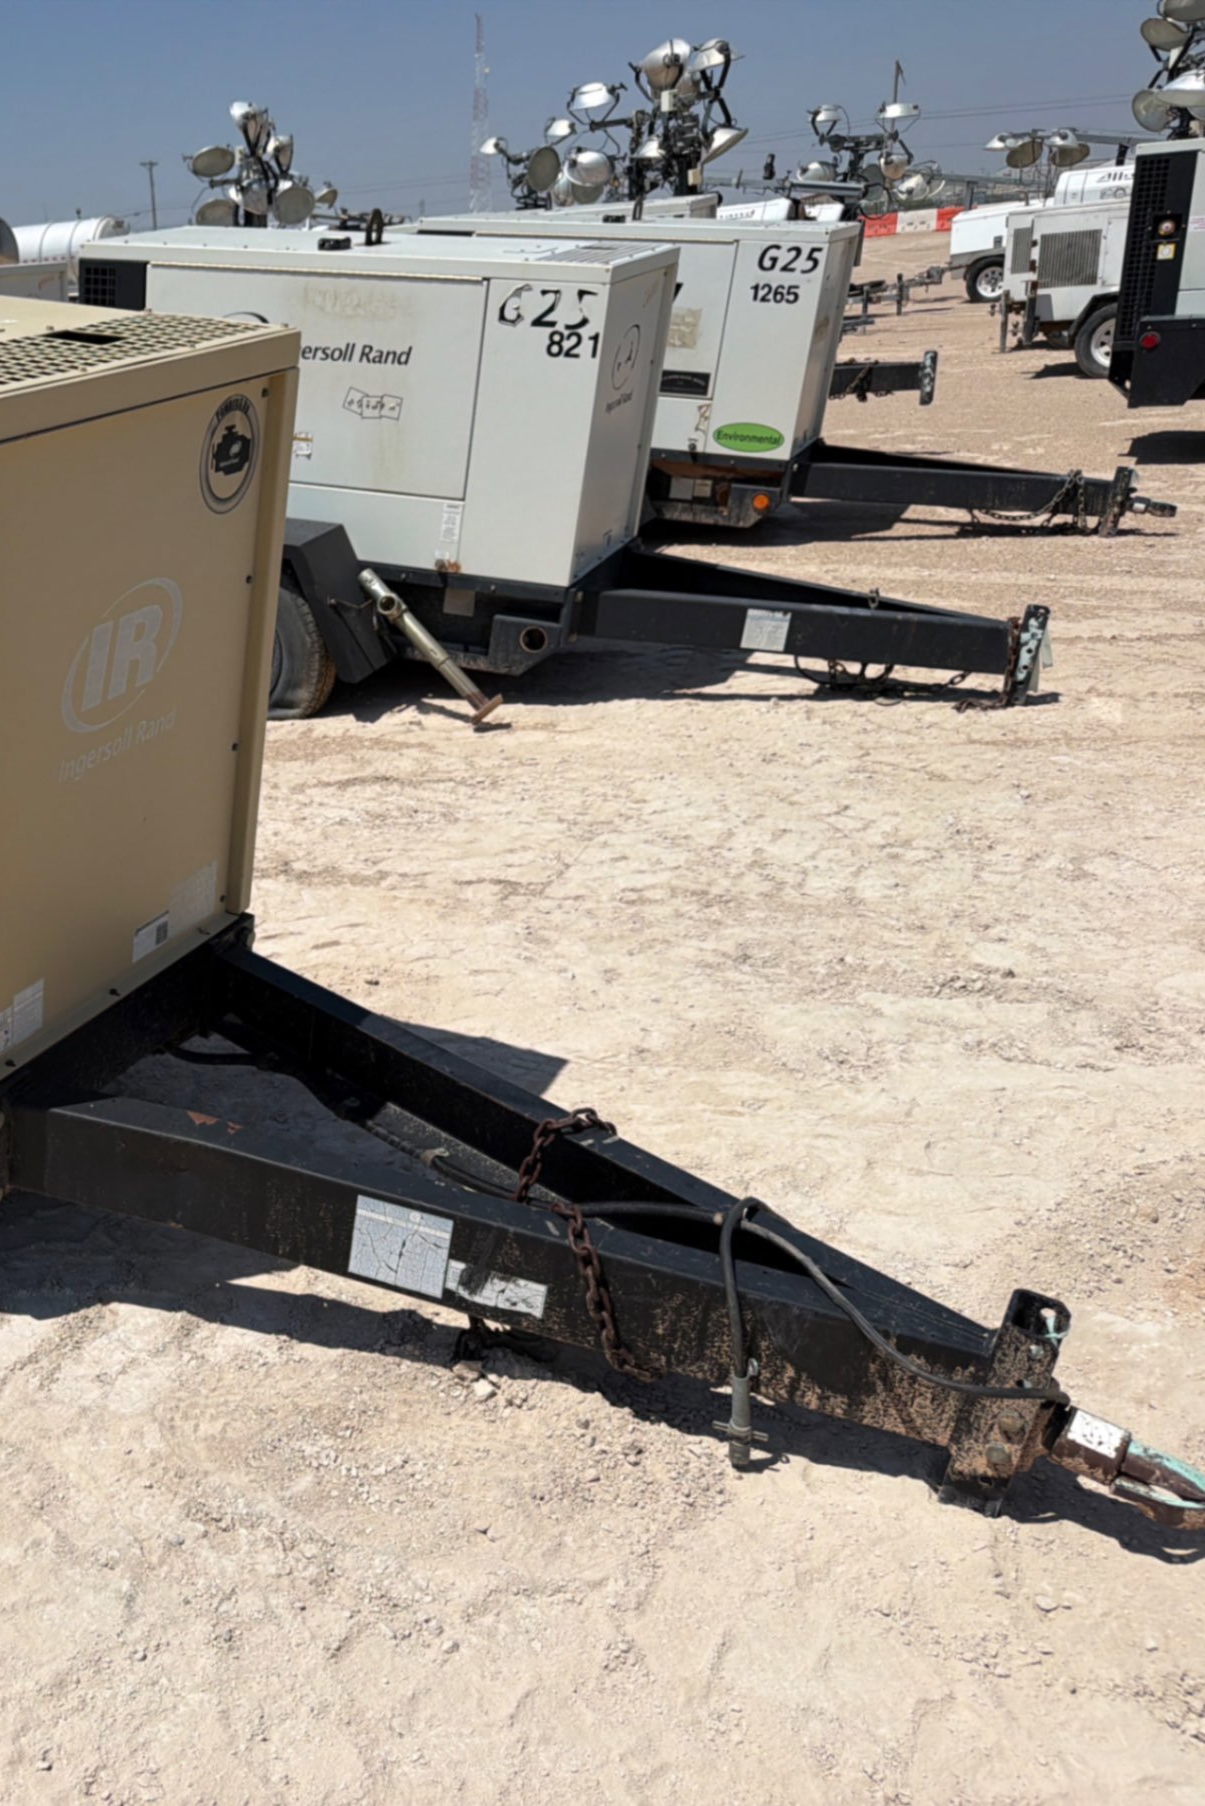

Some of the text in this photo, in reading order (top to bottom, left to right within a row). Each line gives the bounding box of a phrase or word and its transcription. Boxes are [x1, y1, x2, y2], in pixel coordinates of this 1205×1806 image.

[758, 244, 823, 274] G25
[750, 283, 800, 304] 1265
[301, 343, 413, 366] ersoll Rand
[546, 330, 600, 359] 821
[716, 429, 782, 446] Environmental
[81, 604, 163, 712] IR
[58, 706, 176, 783] Ingersoll Rand
